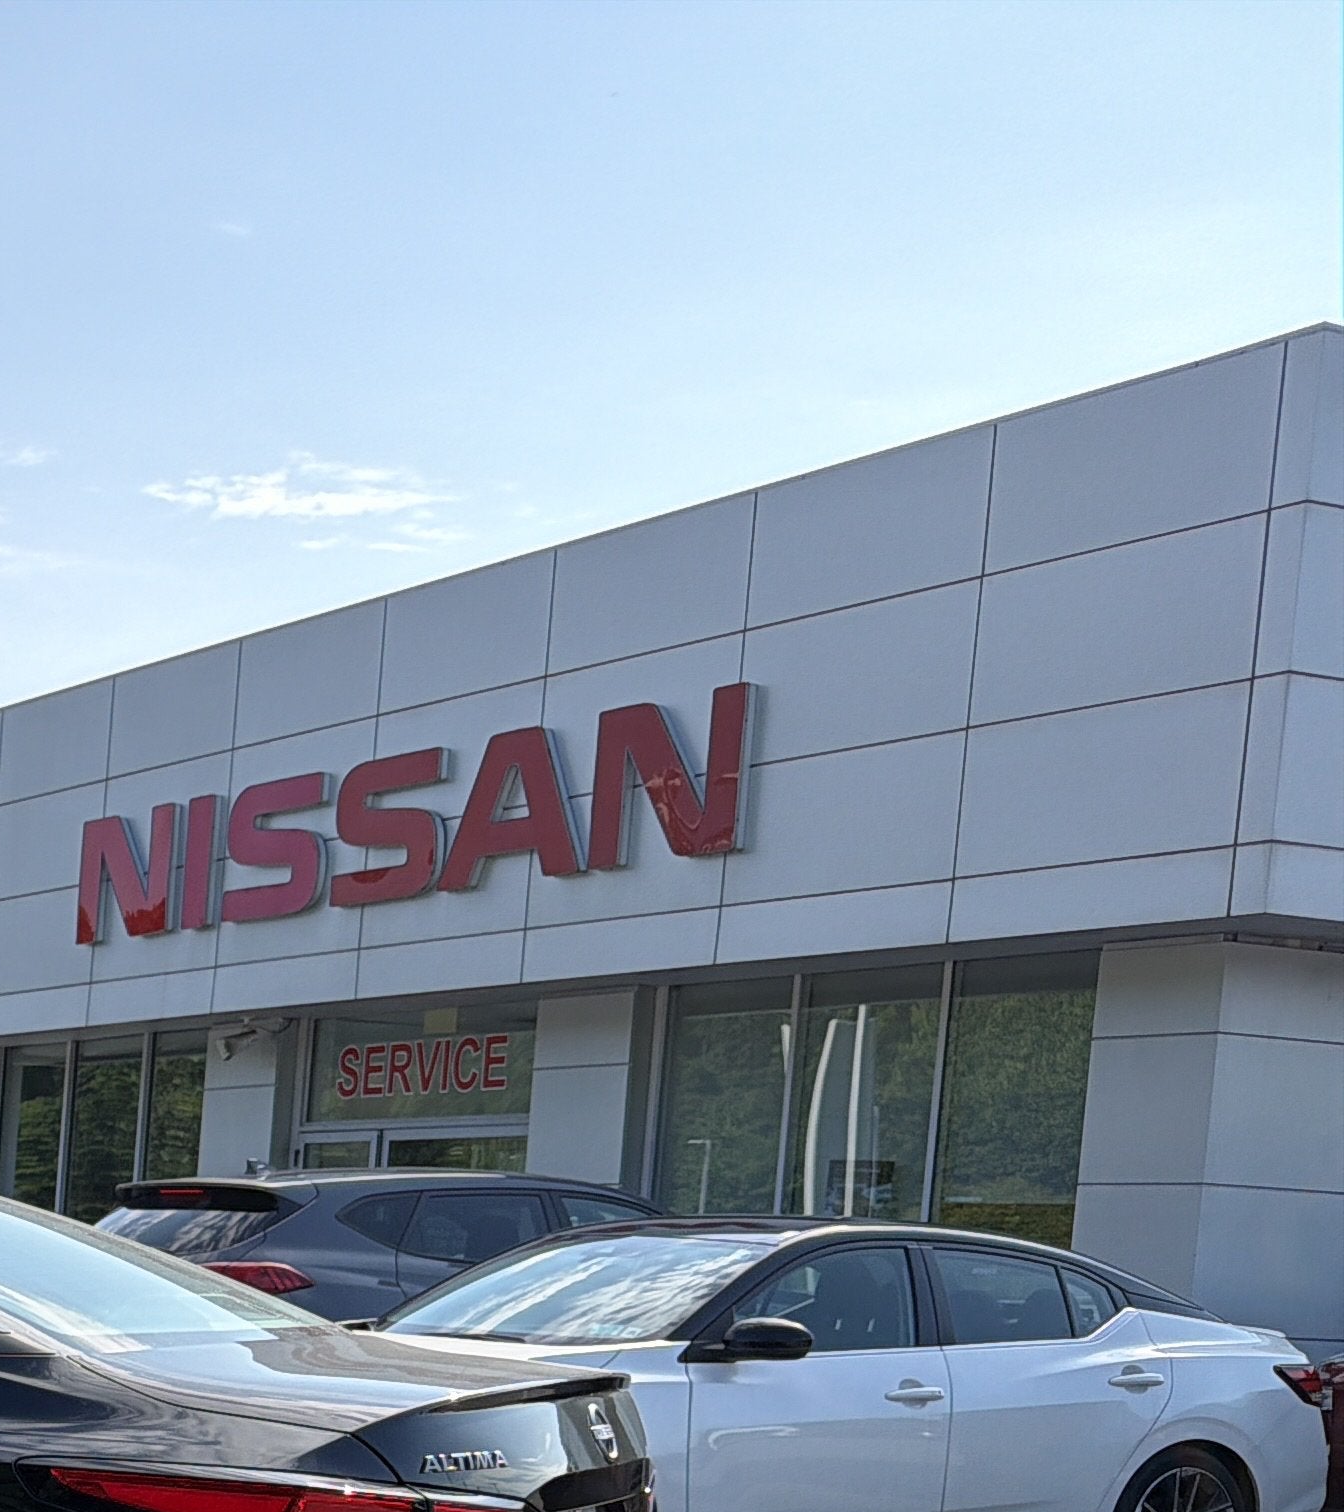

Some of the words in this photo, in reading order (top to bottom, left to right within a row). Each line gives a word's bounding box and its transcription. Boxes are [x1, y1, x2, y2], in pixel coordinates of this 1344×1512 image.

[76, 682, 758, 945] NISSAN
[335, 1032, 509, 1100] SERVICE
[419, 1449, 509, 1474] ALTIMA
